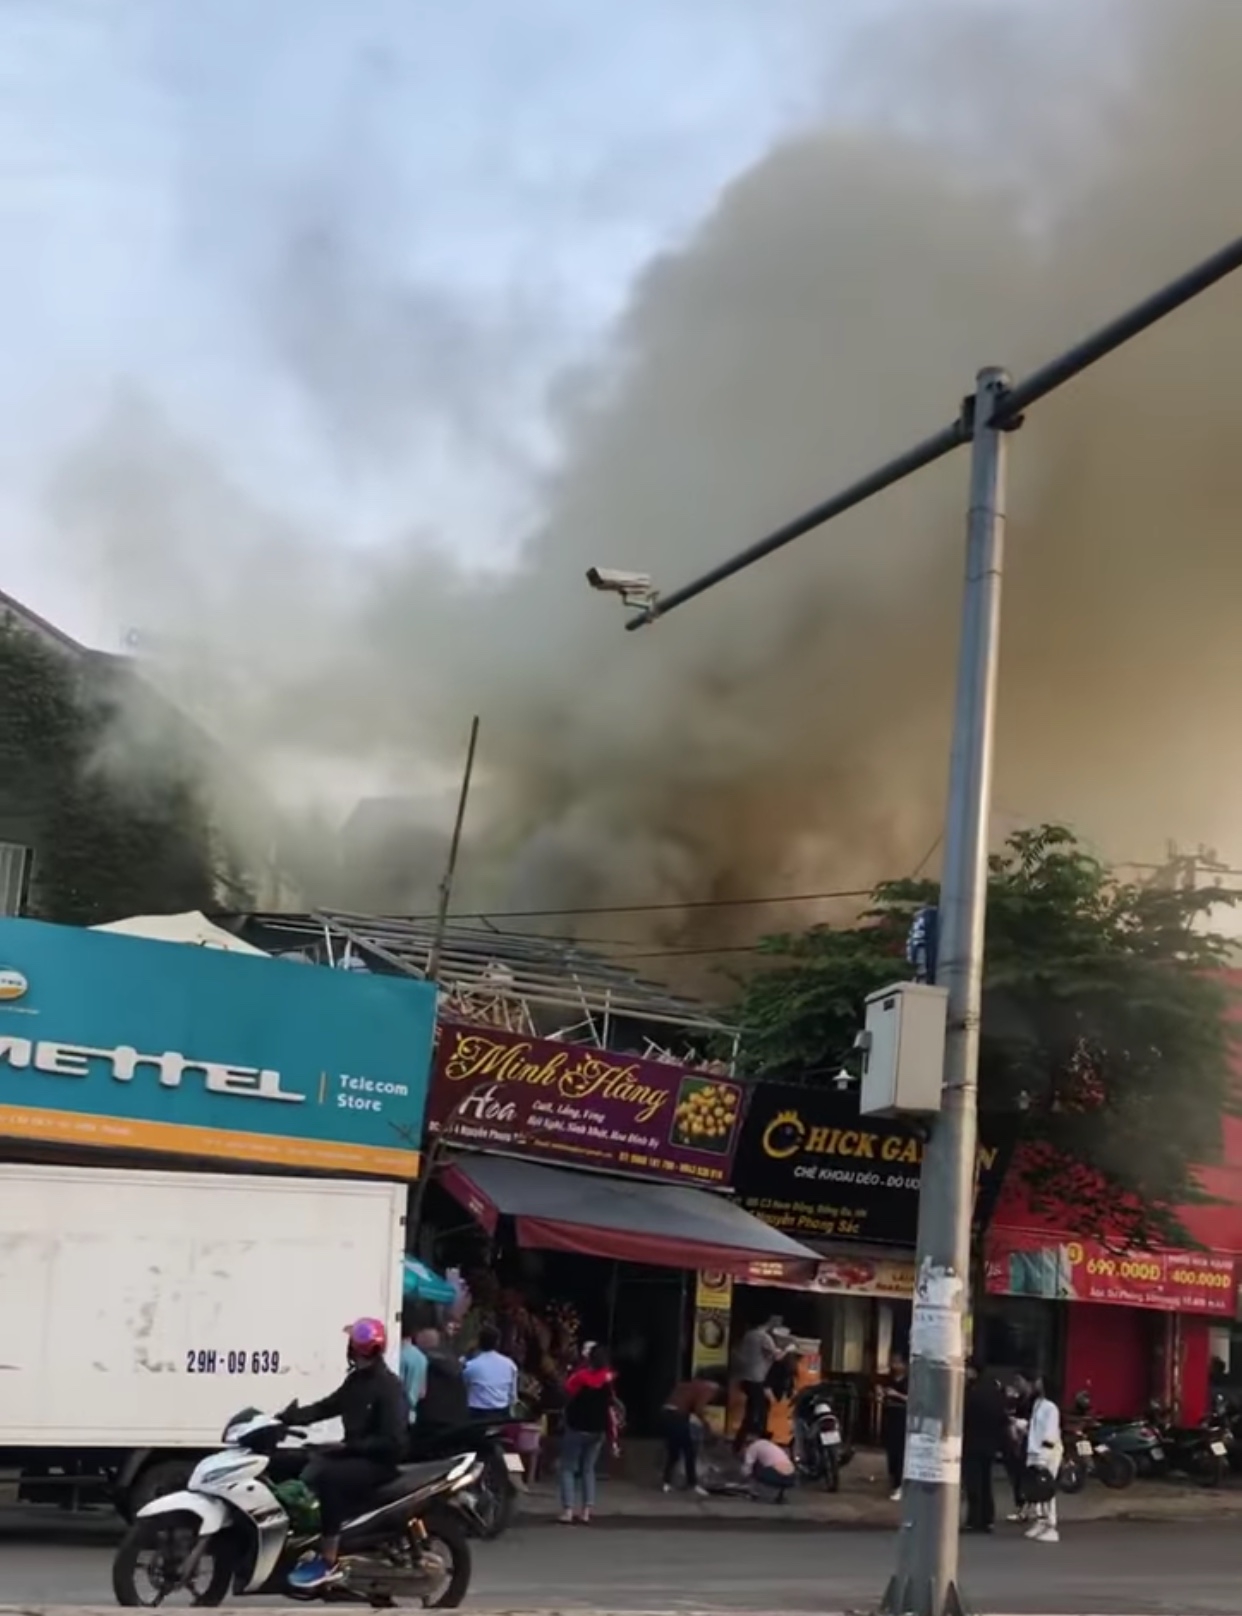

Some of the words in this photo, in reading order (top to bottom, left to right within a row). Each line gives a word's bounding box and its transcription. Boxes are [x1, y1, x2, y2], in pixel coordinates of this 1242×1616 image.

[445, 1032, 568, 1087] Minh
[339, 1074, 409, 1096] Telecom
[337, 1093, 382, 1112] Store
[458, 1084, 517, 1121] Hoa
